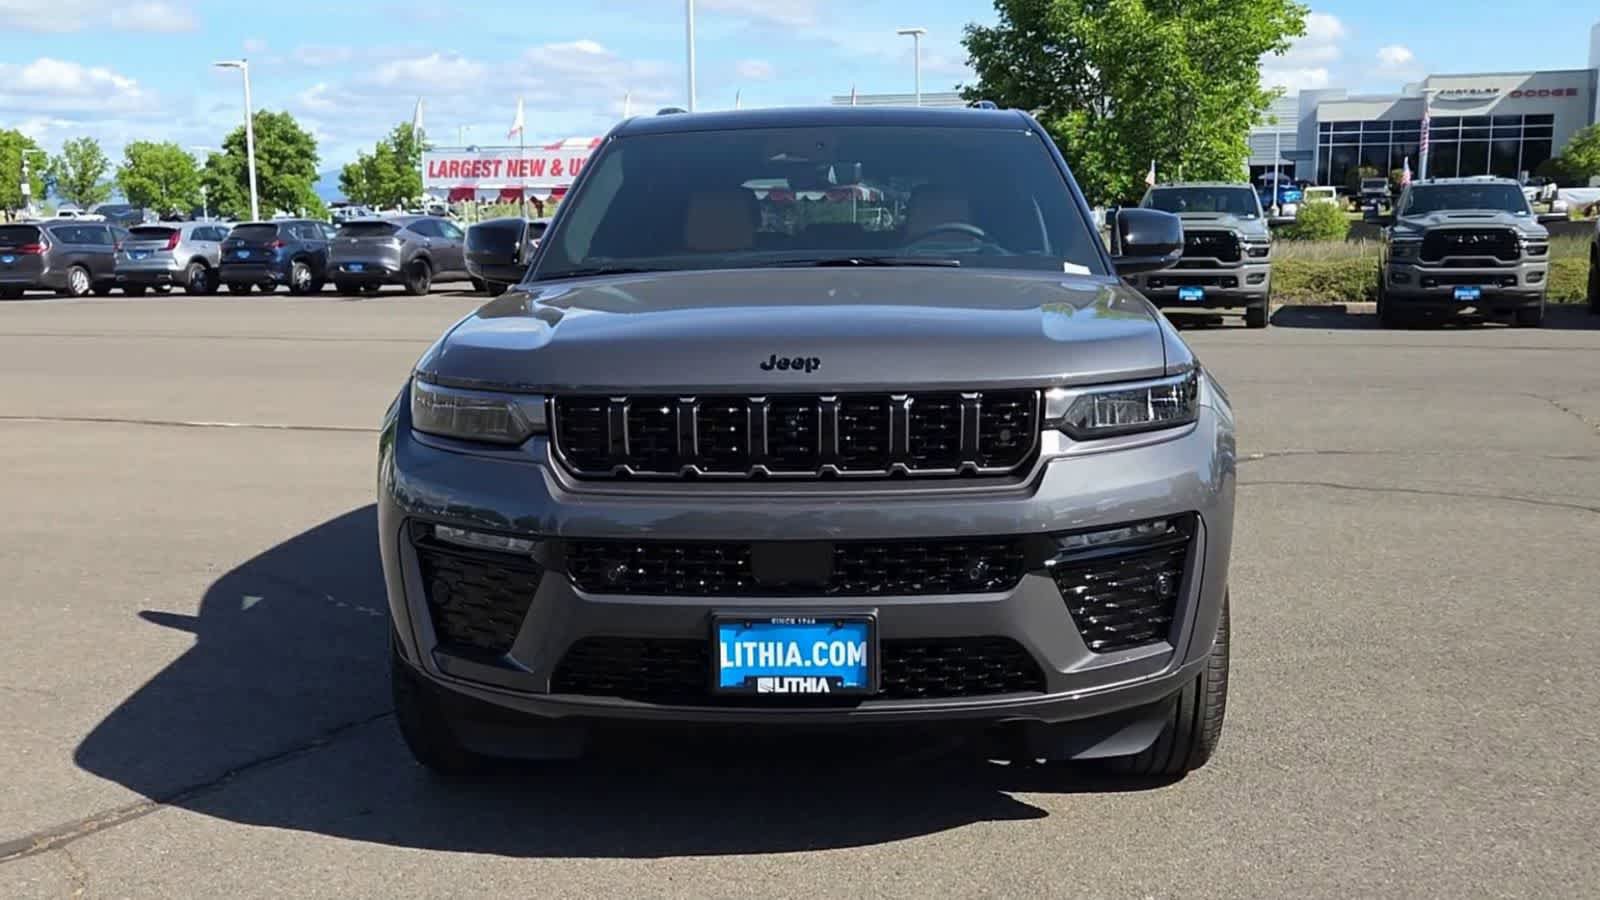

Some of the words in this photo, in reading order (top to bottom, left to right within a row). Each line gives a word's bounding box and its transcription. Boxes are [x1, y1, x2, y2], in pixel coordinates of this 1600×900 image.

[1509, 87, 1579, 98] DODGE
[428, 159, 503, 179] LARGEST
[506, 158, 546, 178] NEW
[550, 158, 564, 177] &
[760, 354, 821, 374] Jeep
[720, 641, 867, 667] LITHIA.COM
[775, 677, 831, 693] LITHIA
